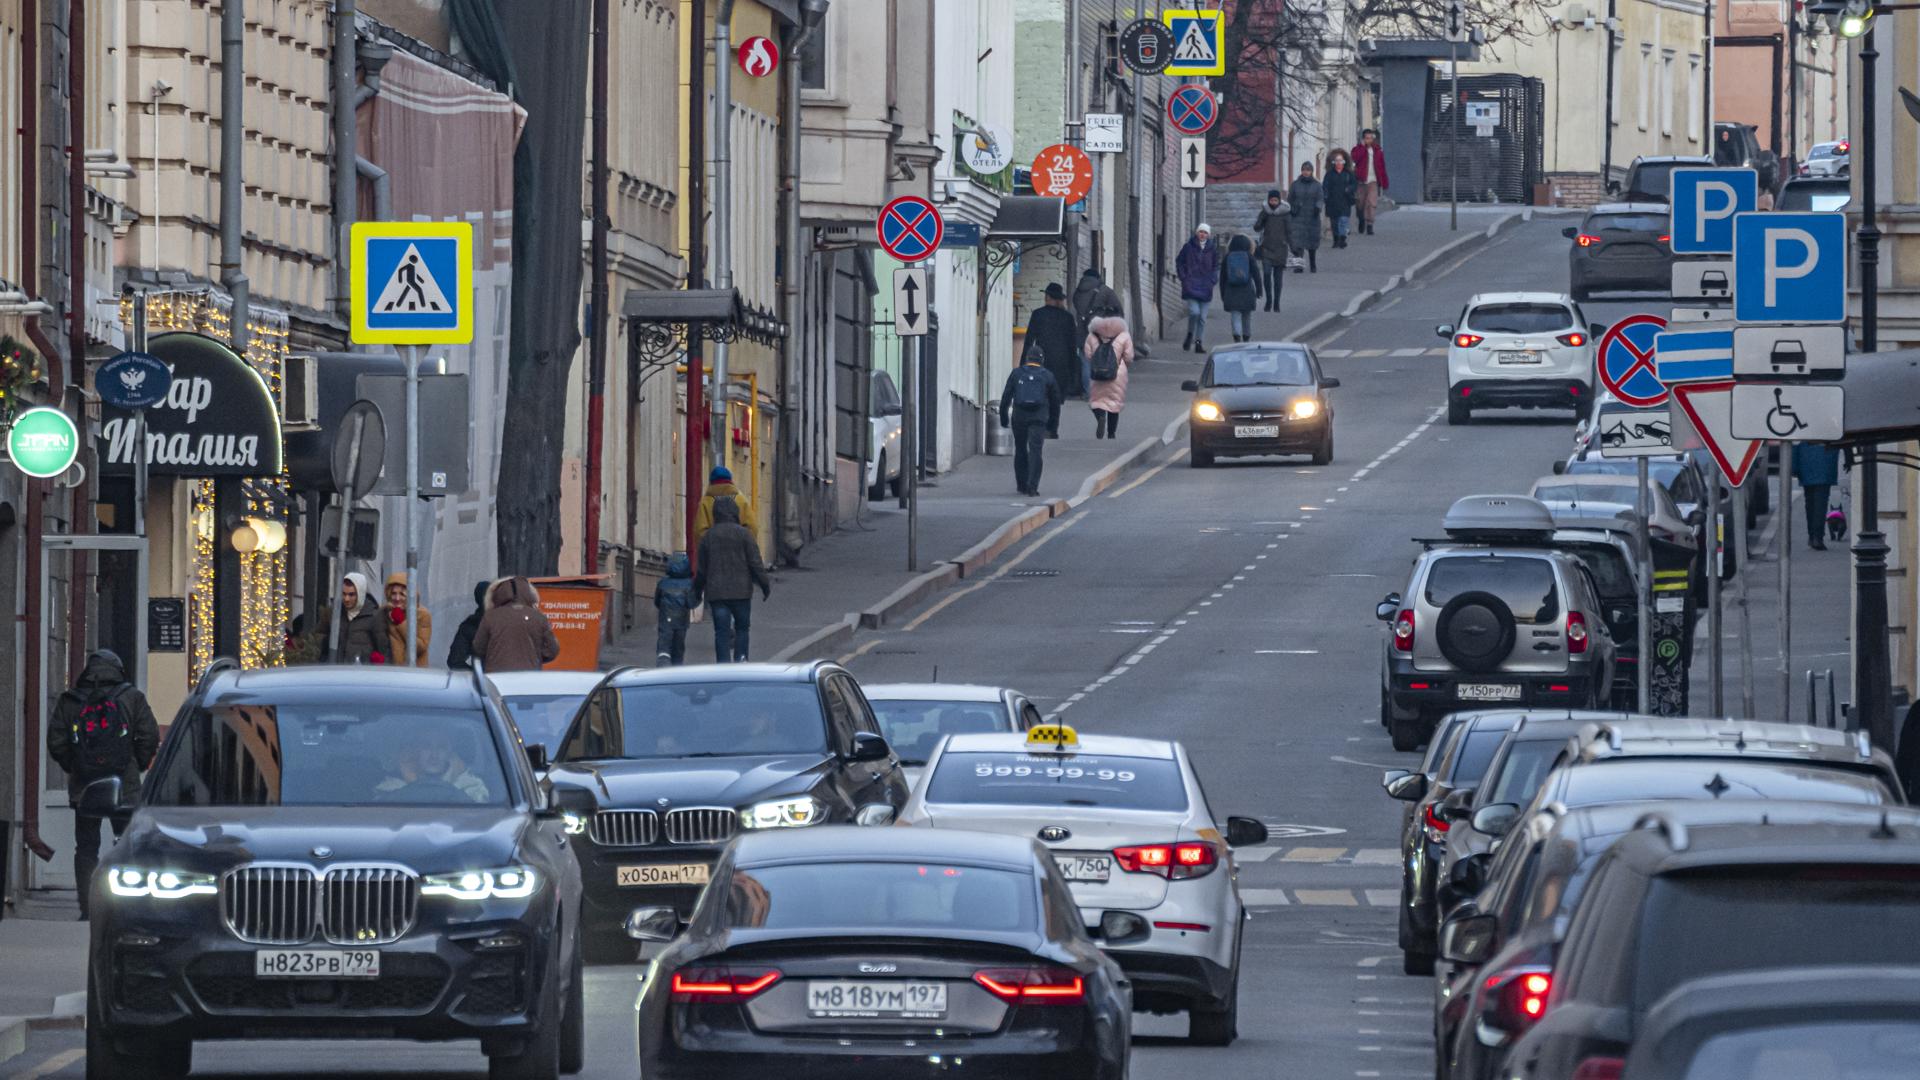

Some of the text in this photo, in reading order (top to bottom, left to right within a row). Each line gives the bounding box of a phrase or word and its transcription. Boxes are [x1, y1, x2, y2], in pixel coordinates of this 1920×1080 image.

[972, 159, 1004, 167] ОТЕЛЬ
[1052, 155, 1074, 172] 24
[1695, 181, 1738, 242] P
[1764, 228, 1820, 307] P
[975, 766, 1136, 782] 999-99-99
[1078, 859, 1104, 872] 750
[622, 866, 705, 883] Х050АН 177
[263, 952, 374, 972] Н823РВ 799
[858, 962, 897, 973] Turbo
[815, 985, 940, 1007] М818УМ 197
